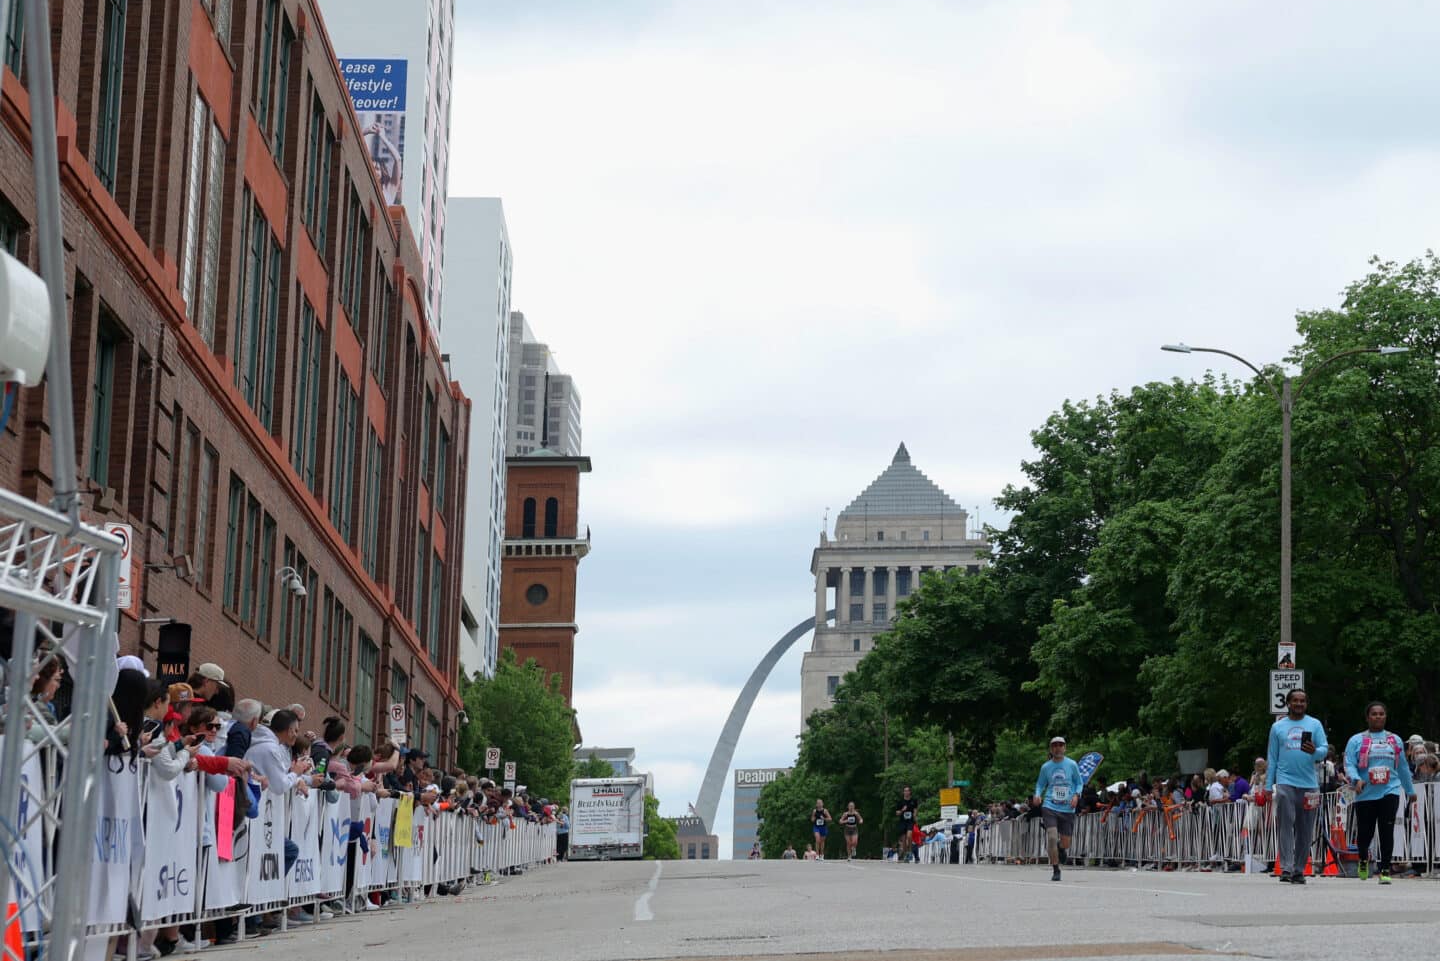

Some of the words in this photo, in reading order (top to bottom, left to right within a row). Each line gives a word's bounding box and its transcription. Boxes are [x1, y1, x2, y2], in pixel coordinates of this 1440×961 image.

[383, 63, 392, 74] a
[344, 78, 393, 94] ifestyle
[161, 663, 185, 676] WALK
[1274, 673, 1301, 682] SPEED
[1277, 682, 1297, 690] LIMIT
[1274, 692, 1287, 709] 3
[737, 770, 776, 784] Peabo
